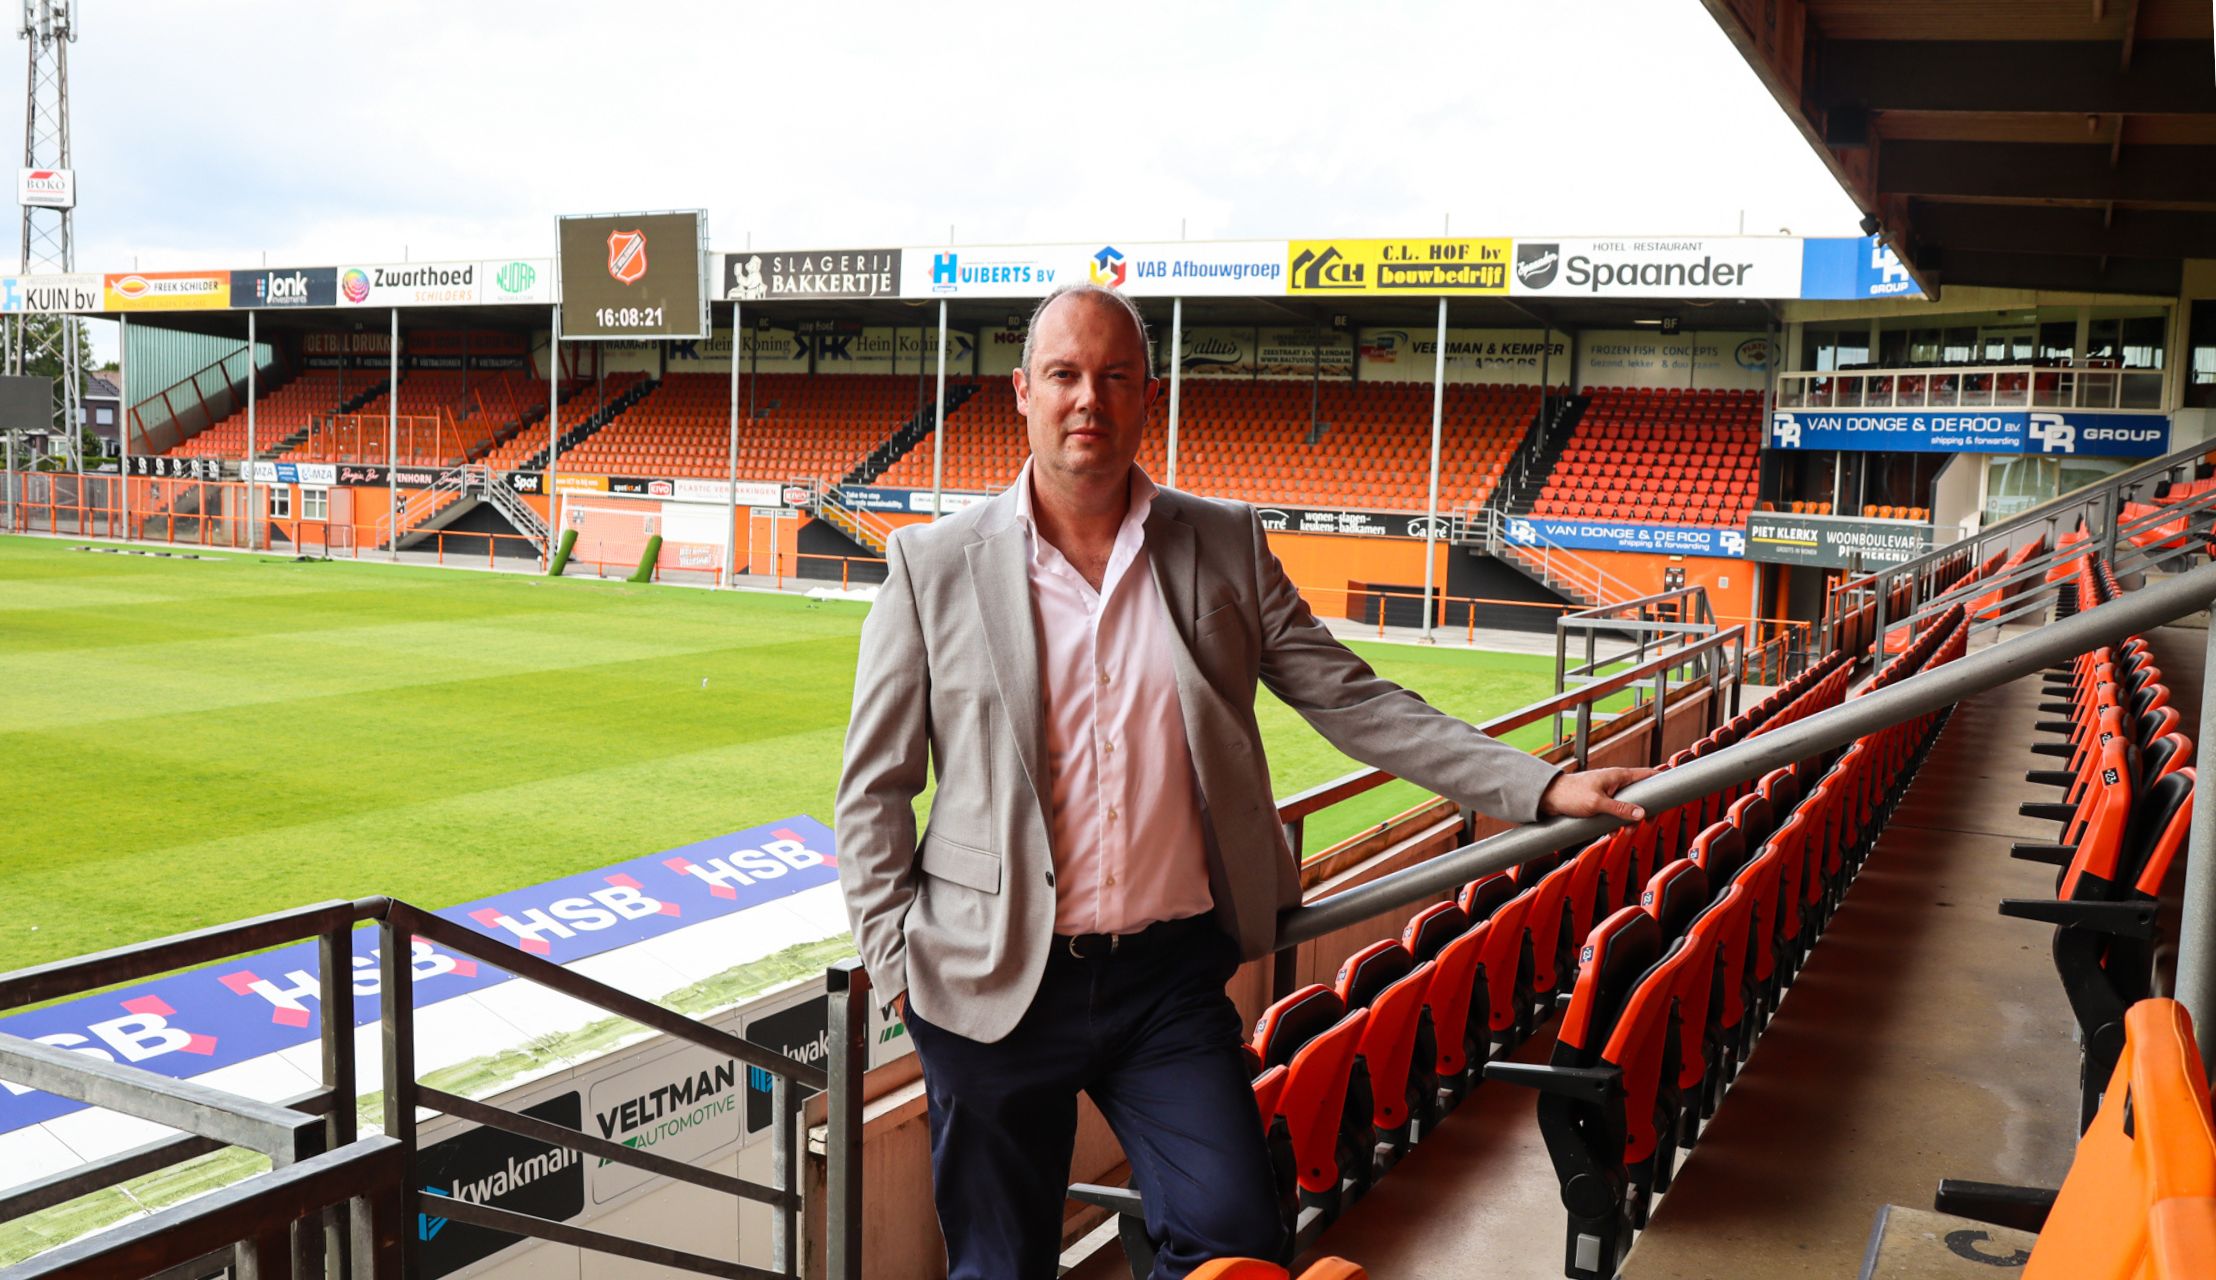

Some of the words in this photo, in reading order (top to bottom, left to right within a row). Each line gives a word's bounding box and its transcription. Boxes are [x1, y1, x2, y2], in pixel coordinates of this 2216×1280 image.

[27, 179, 65, 190] BOKO
[1383, 245, 1420, 260] C.L.
[1430, 244, 1470, 260] HOF
[1481, 244, 1501, 259] bv
[1593, 242, 1626, 252] HOTEL
[1633, 241, 1704, 252] RESTAURANT
[773, 255, 891, 273] SLAGERIJ
[933, 254, 1031, 284] HUIBERTS
[1036, 269, 1055, 282] BV
[1137, 261, 1167, 277] VAB
[1172, 260, 1280, 280] Afbouwgroep
[1325, 263, 1364, 282] CH
[374, 264, 473, 287] Zwarthoed
[1382, 265, 1503, 287] bouwbedrijf
[1566, 255, 1753, 292] Spaander
[154, 281, 178, 292] FREEK
[180, 279, 219, 291] SCHILDER
[771, 273, 891, 296] BAKKERTJE
[1870, 281, 1909, 294] GROUP
[26, 288, 70, 311] KUIN
[75, 288, 96, 309] bv
[415, 290, 473, 302] SCHILDERS
[595, 307, 663, 328] 16:08:21
[742, 336, 791, 353] Koning
[857, 336, 890, 352] Hein
[1412, 342, 1483, 354] VEEMAN
[1487, 343, 1497, 354] &
[1501, 343, 1565, 356] KEMPER
[1590, 344, 1631, 355] FROZEN
[1633, 345, 1656, 355] FISH
[1662, 345, 1719, 356] CONCEPTS
[1773, 413, 1801, 448] DR
[1807, 417, 1842, 431] VAN
[1846, 417, 1908, 431] DONGE
[1912, 418, 1927, 431] &
[2029, 413, 2076, 452] DR
[1931, 436, 1964, 447] shipping
[1966, 436, 1973, 445] &
[1974, 436, 2020, 447] forwarding
[2083, 428, 2162, 442] GROUP
[513, 475, 538, 491] Spot
[651, 484, 670, 494] KIVO
[678, 483, 712, 493] PLASTIC
[714, 485, 776, 496] VERAKKINGEN
[1261, 517, 1287, 530] arré
[1407, 522, 1447, 538] Caré
[1544, 525, 1577, 536] VAN
[1580, 527, 1635, 539] DONGE
[1638, 528, 1650, 540] &
[1752, 525, 1775, 539] PIET
[1777, 526, 1818, 542] KLERKX
[1618, 538, 1653, 548] shipping
[1655, 540, 1662, 548] &
[1664, 540, 1710, 551] forwarding
[1719, 531, 1746, 556] DR
[684, 839, 824, 889] HSB
[494, 886, 663, 942] HSB
[596, 1059, 735, 1140] VELTMAN
[636, 1093, 735, 1150] AUTOMOTIVE
[452, 1146, 578, 1206] kwakman
